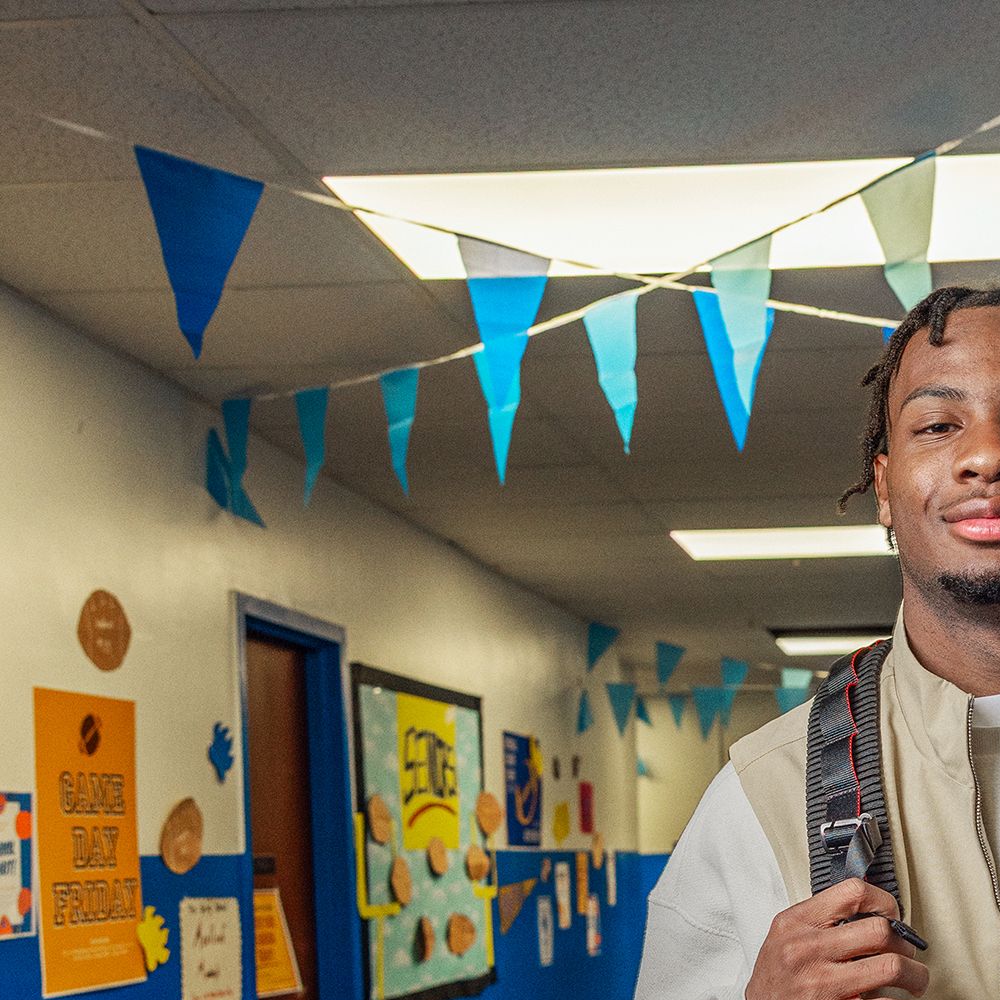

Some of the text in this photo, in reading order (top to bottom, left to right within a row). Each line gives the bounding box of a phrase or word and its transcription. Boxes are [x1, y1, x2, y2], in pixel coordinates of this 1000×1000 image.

[59, 771, 125, 817] GAME
[71, 825, 119, 869] DAY
[52, 877, 138, 927] FRIDAY
